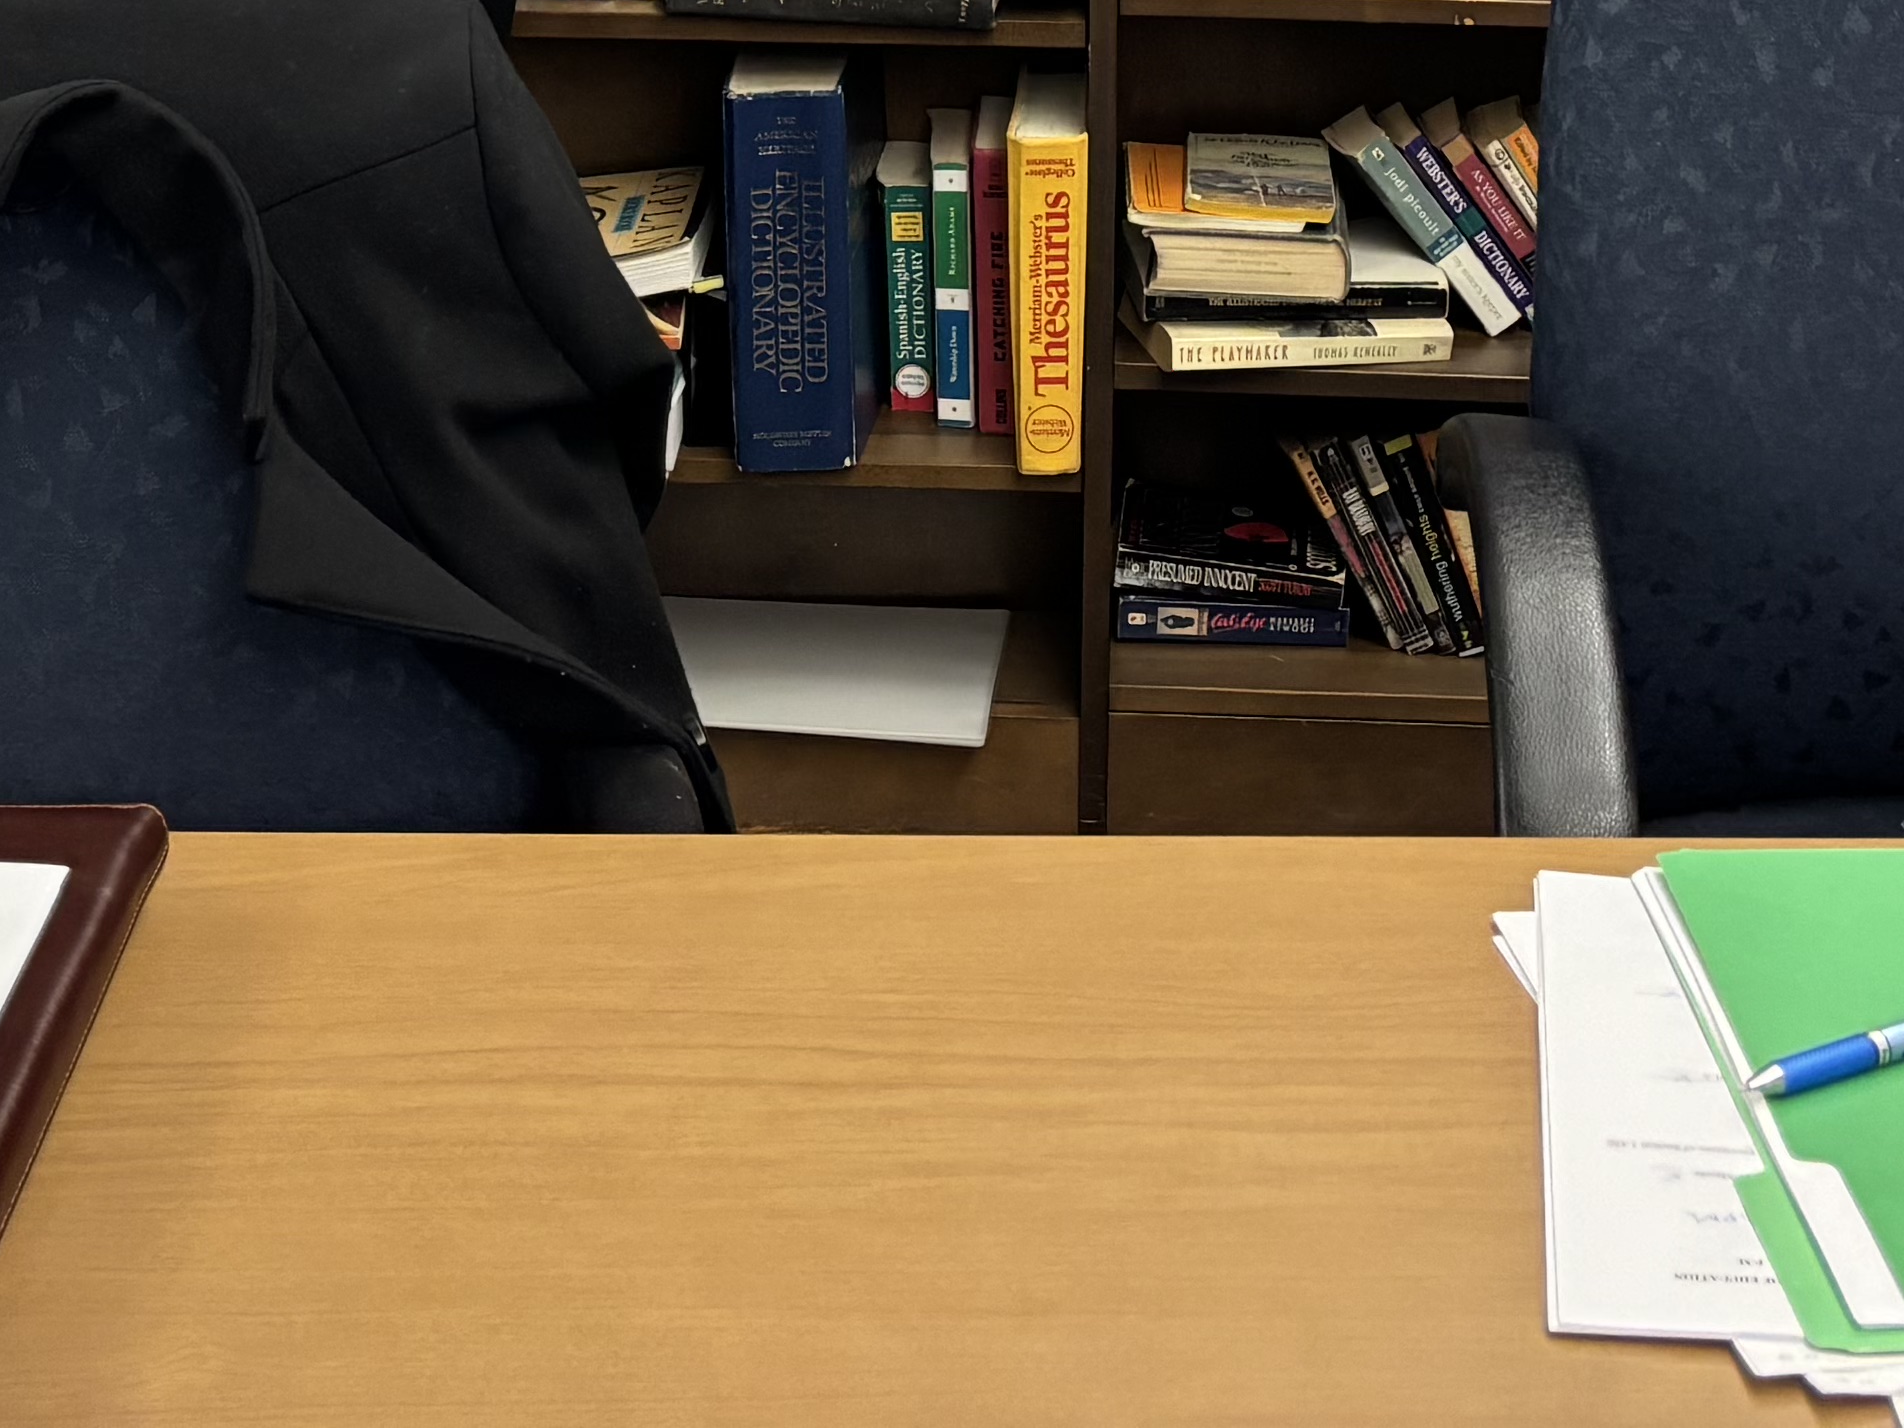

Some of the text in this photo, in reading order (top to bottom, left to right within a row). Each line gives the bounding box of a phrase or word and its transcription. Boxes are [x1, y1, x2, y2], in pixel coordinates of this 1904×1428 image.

[750, 187, 777, 377] DICTIONARY
[775, 168, 804, 394] ENCYCLOPEDIC
[802, 178, 829, 384] ILLUSTRATED
[1403, 192, 1440, 237] picoult
[1416, 146, 1468, 214] WEBSTER'S
[1473, 230, 1530, 300] DICTIONARY
[912, 248, 927, 359] DICTIONARY
[1033, 191, 1072, 398] Thesaurus
[1178, 342, 1290, 364] THE PLAYMAKER
[1147, 560, 1258, 593] PRESUMED INNOCENT
